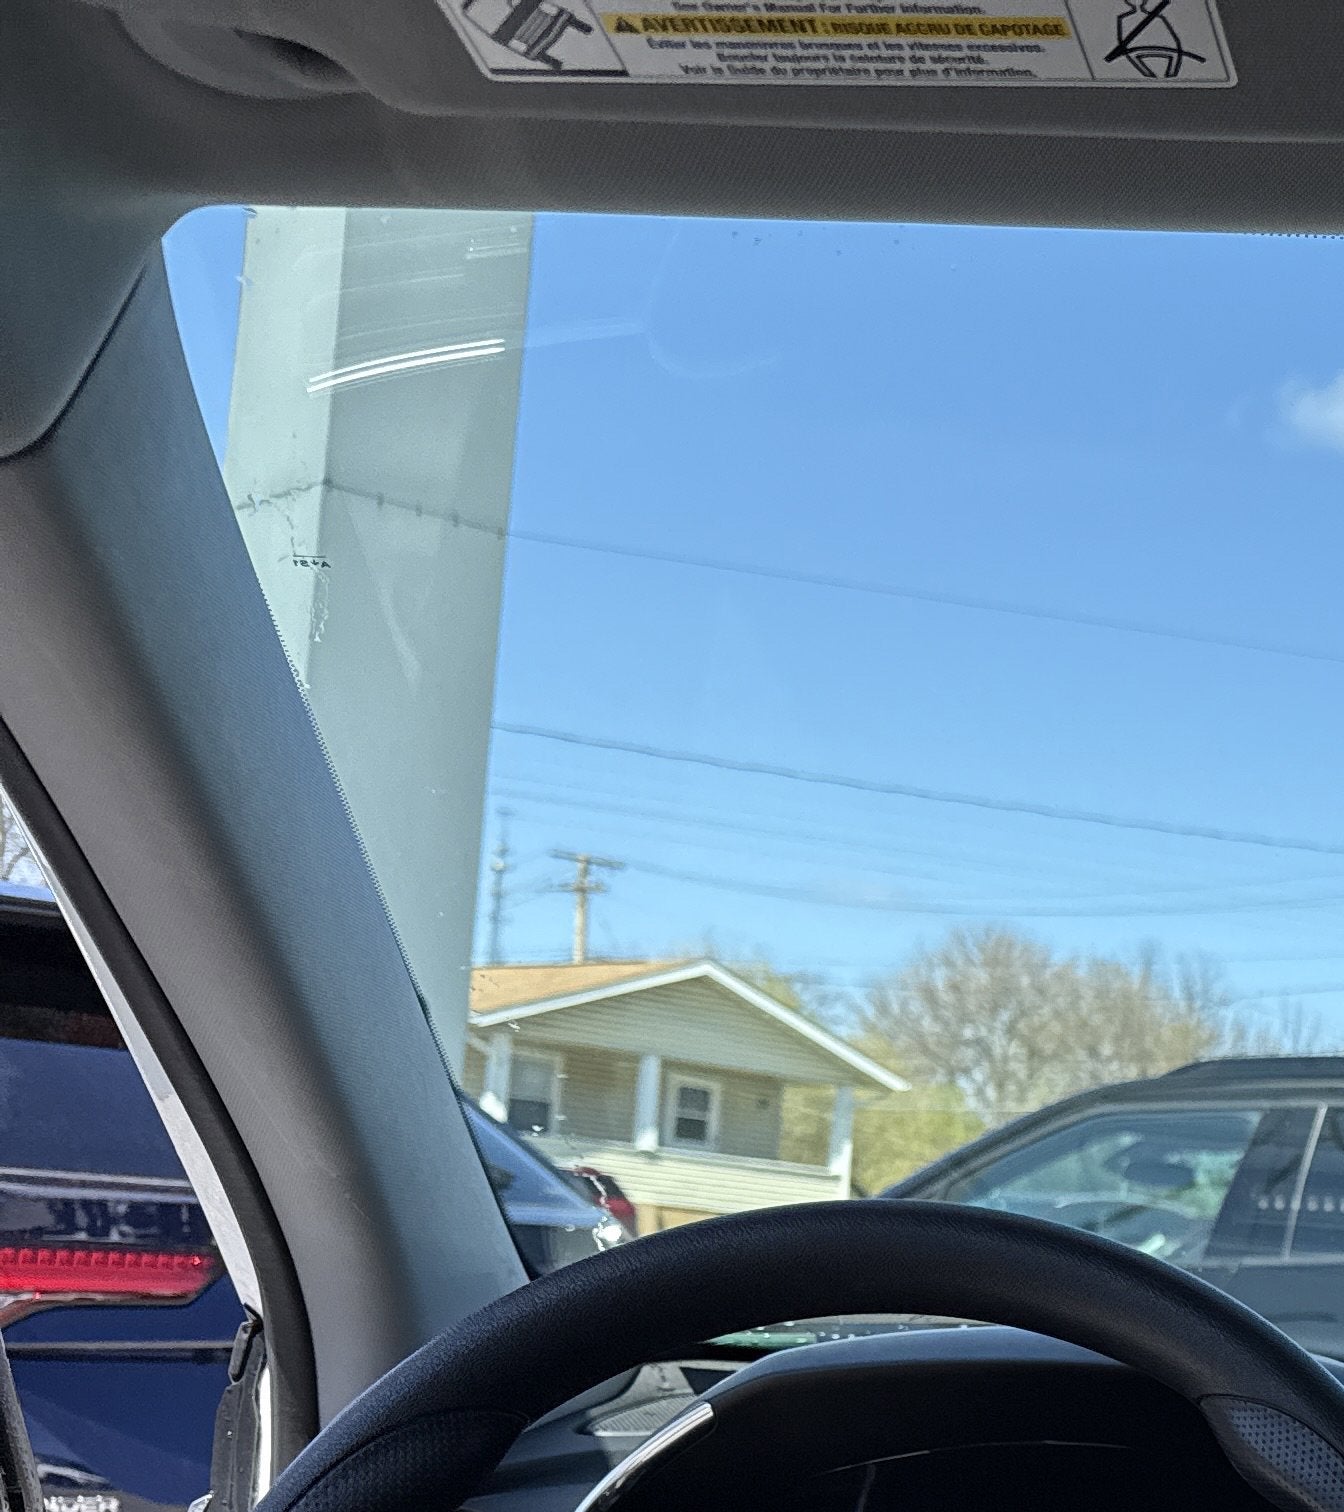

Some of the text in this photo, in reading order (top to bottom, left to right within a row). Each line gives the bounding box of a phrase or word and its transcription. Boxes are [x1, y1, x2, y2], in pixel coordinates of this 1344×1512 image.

[642, 17, 818, 34] AVERTISSEMENT
[954, 22, 973, 36] DE
[978, 23, 1065, 37] CAPOTAGE
